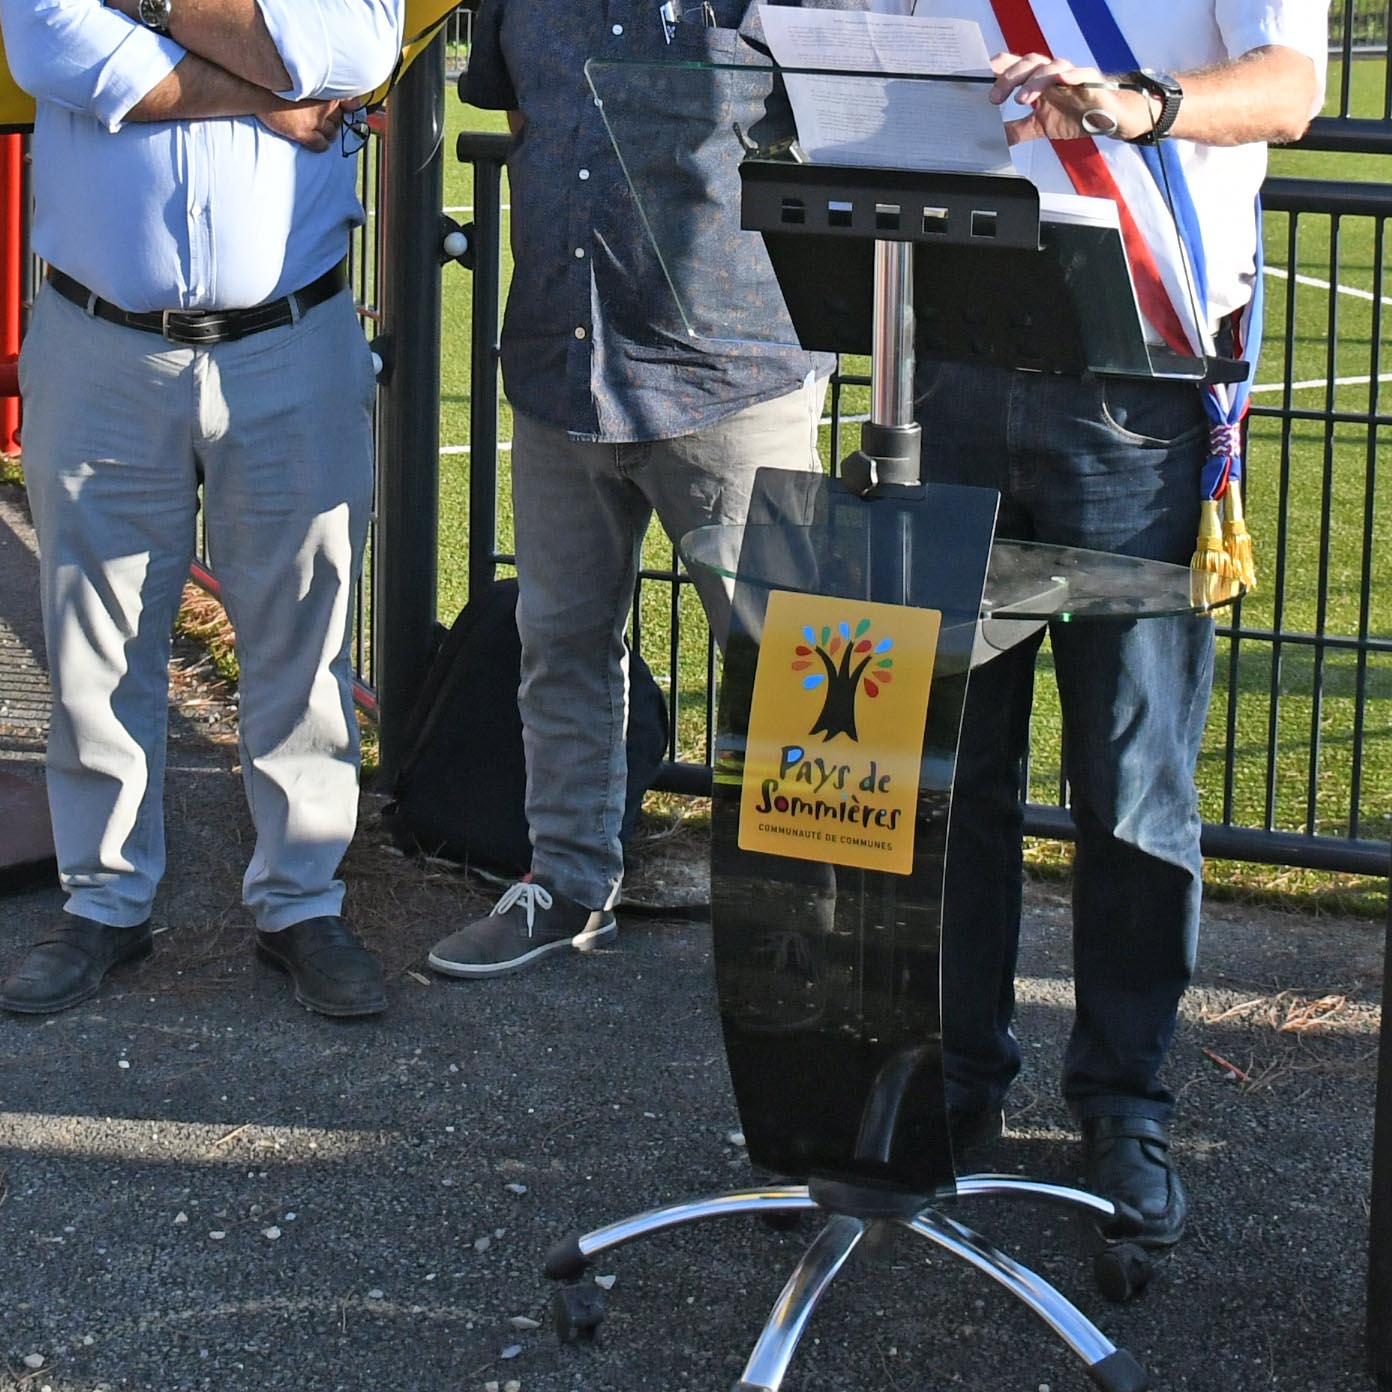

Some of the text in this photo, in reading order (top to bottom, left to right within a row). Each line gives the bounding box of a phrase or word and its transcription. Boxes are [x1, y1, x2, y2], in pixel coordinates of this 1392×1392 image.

[780, 745, 891, 793] Pays de
[755, 778, 901, 830] Sommières
[758, 823, 893, 851] COMMUNAUTÉ DE COMMUNES
